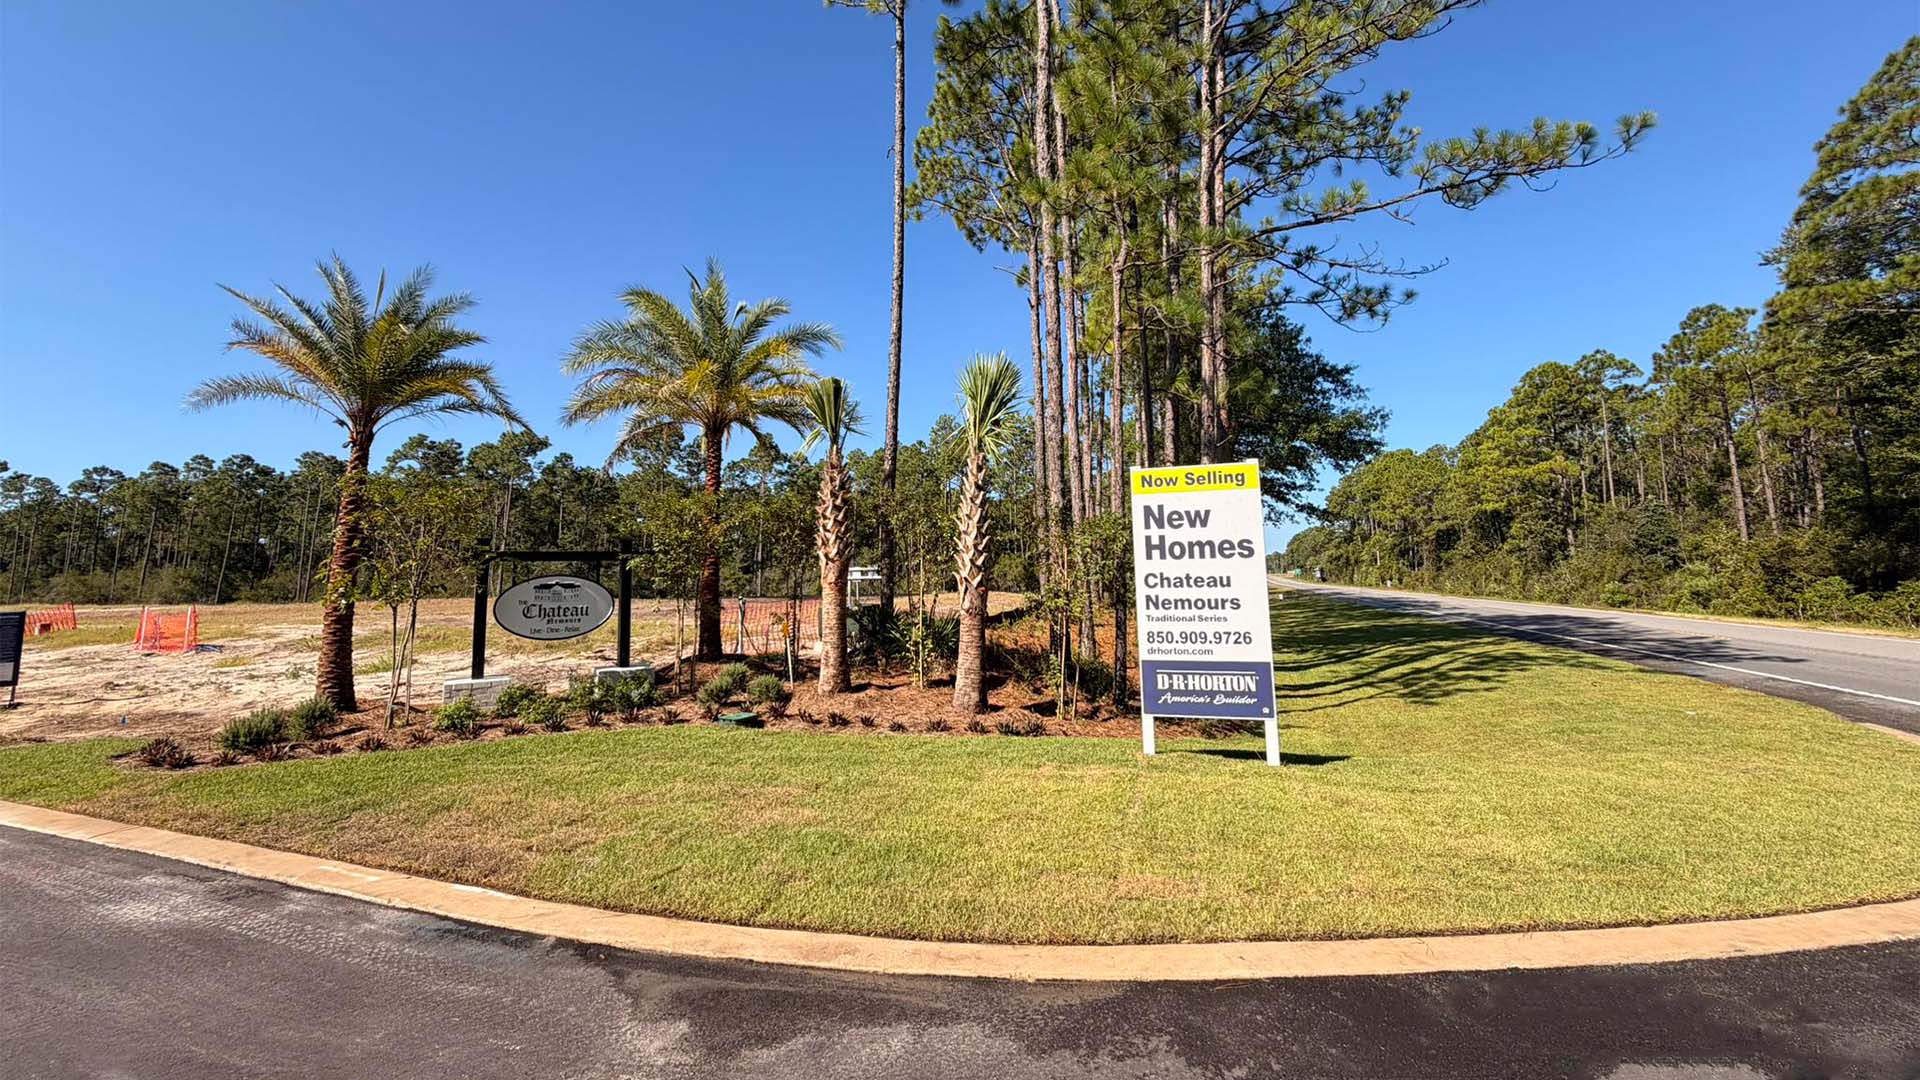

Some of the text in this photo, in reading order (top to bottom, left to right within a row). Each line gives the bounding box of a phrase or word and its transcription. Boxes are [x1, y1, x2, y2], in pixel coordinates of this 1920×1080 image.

[1141, 471, 1245, 488] Now Selling
[1143, 504, 1211, 530] New
[1145, 535, 1255, 560] Homes
[1144, 572, 1232, 589] Chateau
[1145, 594, 1241, 610] Nemours
[522, 603, 590, 621] Chateau
[1146, 614, 1228, 623] Traditional Series
[1146, 631, 1253, 645] 850.909.9726
[1147, 647, 1214, 656] drhorton.com
[1158, 691, 1258, 705] America's Builder
